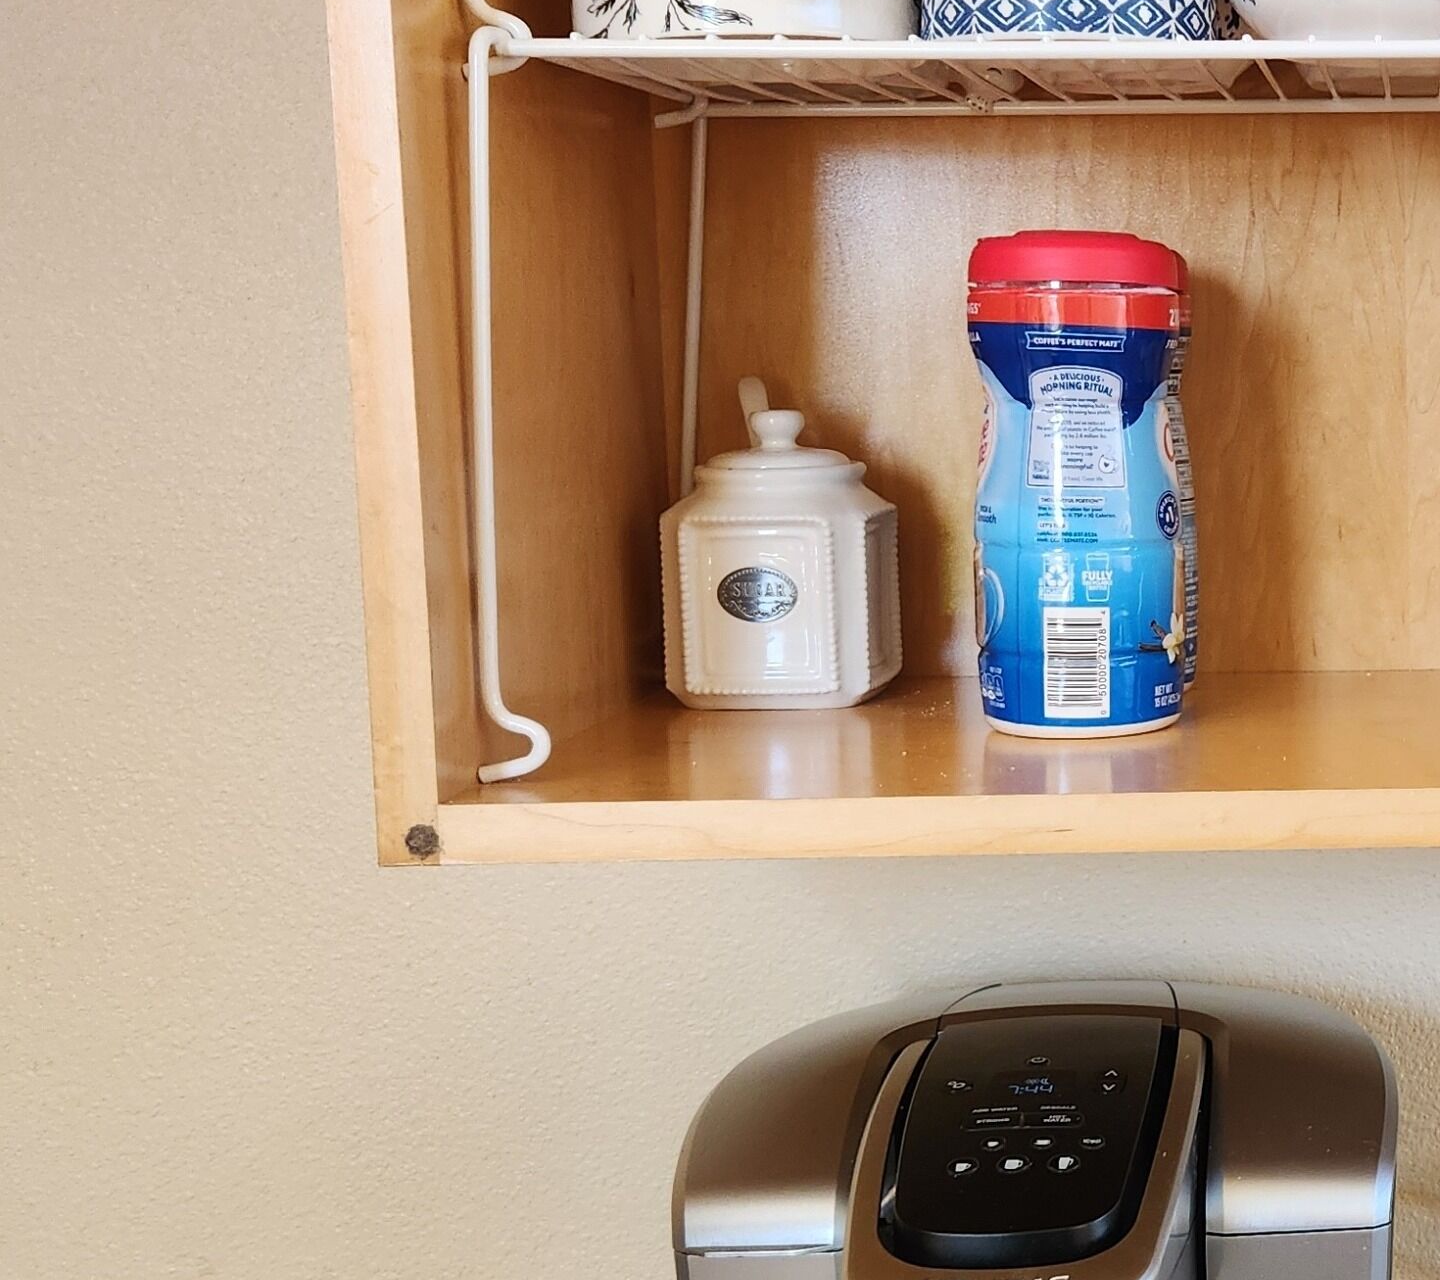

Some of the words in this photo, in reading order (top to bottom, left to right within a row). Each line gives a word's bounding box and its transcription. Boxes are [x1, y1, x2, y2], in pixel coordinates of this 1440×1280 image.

[1060, 373, 1101, 382] DELICIOUS
[1040, 382, 1082, 396] MORNING
[1084, 382, 1114, 398] RITUAL
[1082, 570, 1112, 580] FULLY
[733, 582, 786, 598] SUGAR
[1098, 628, 1106, 660] 20708
[1098, 664, 1106, 696] 50000
